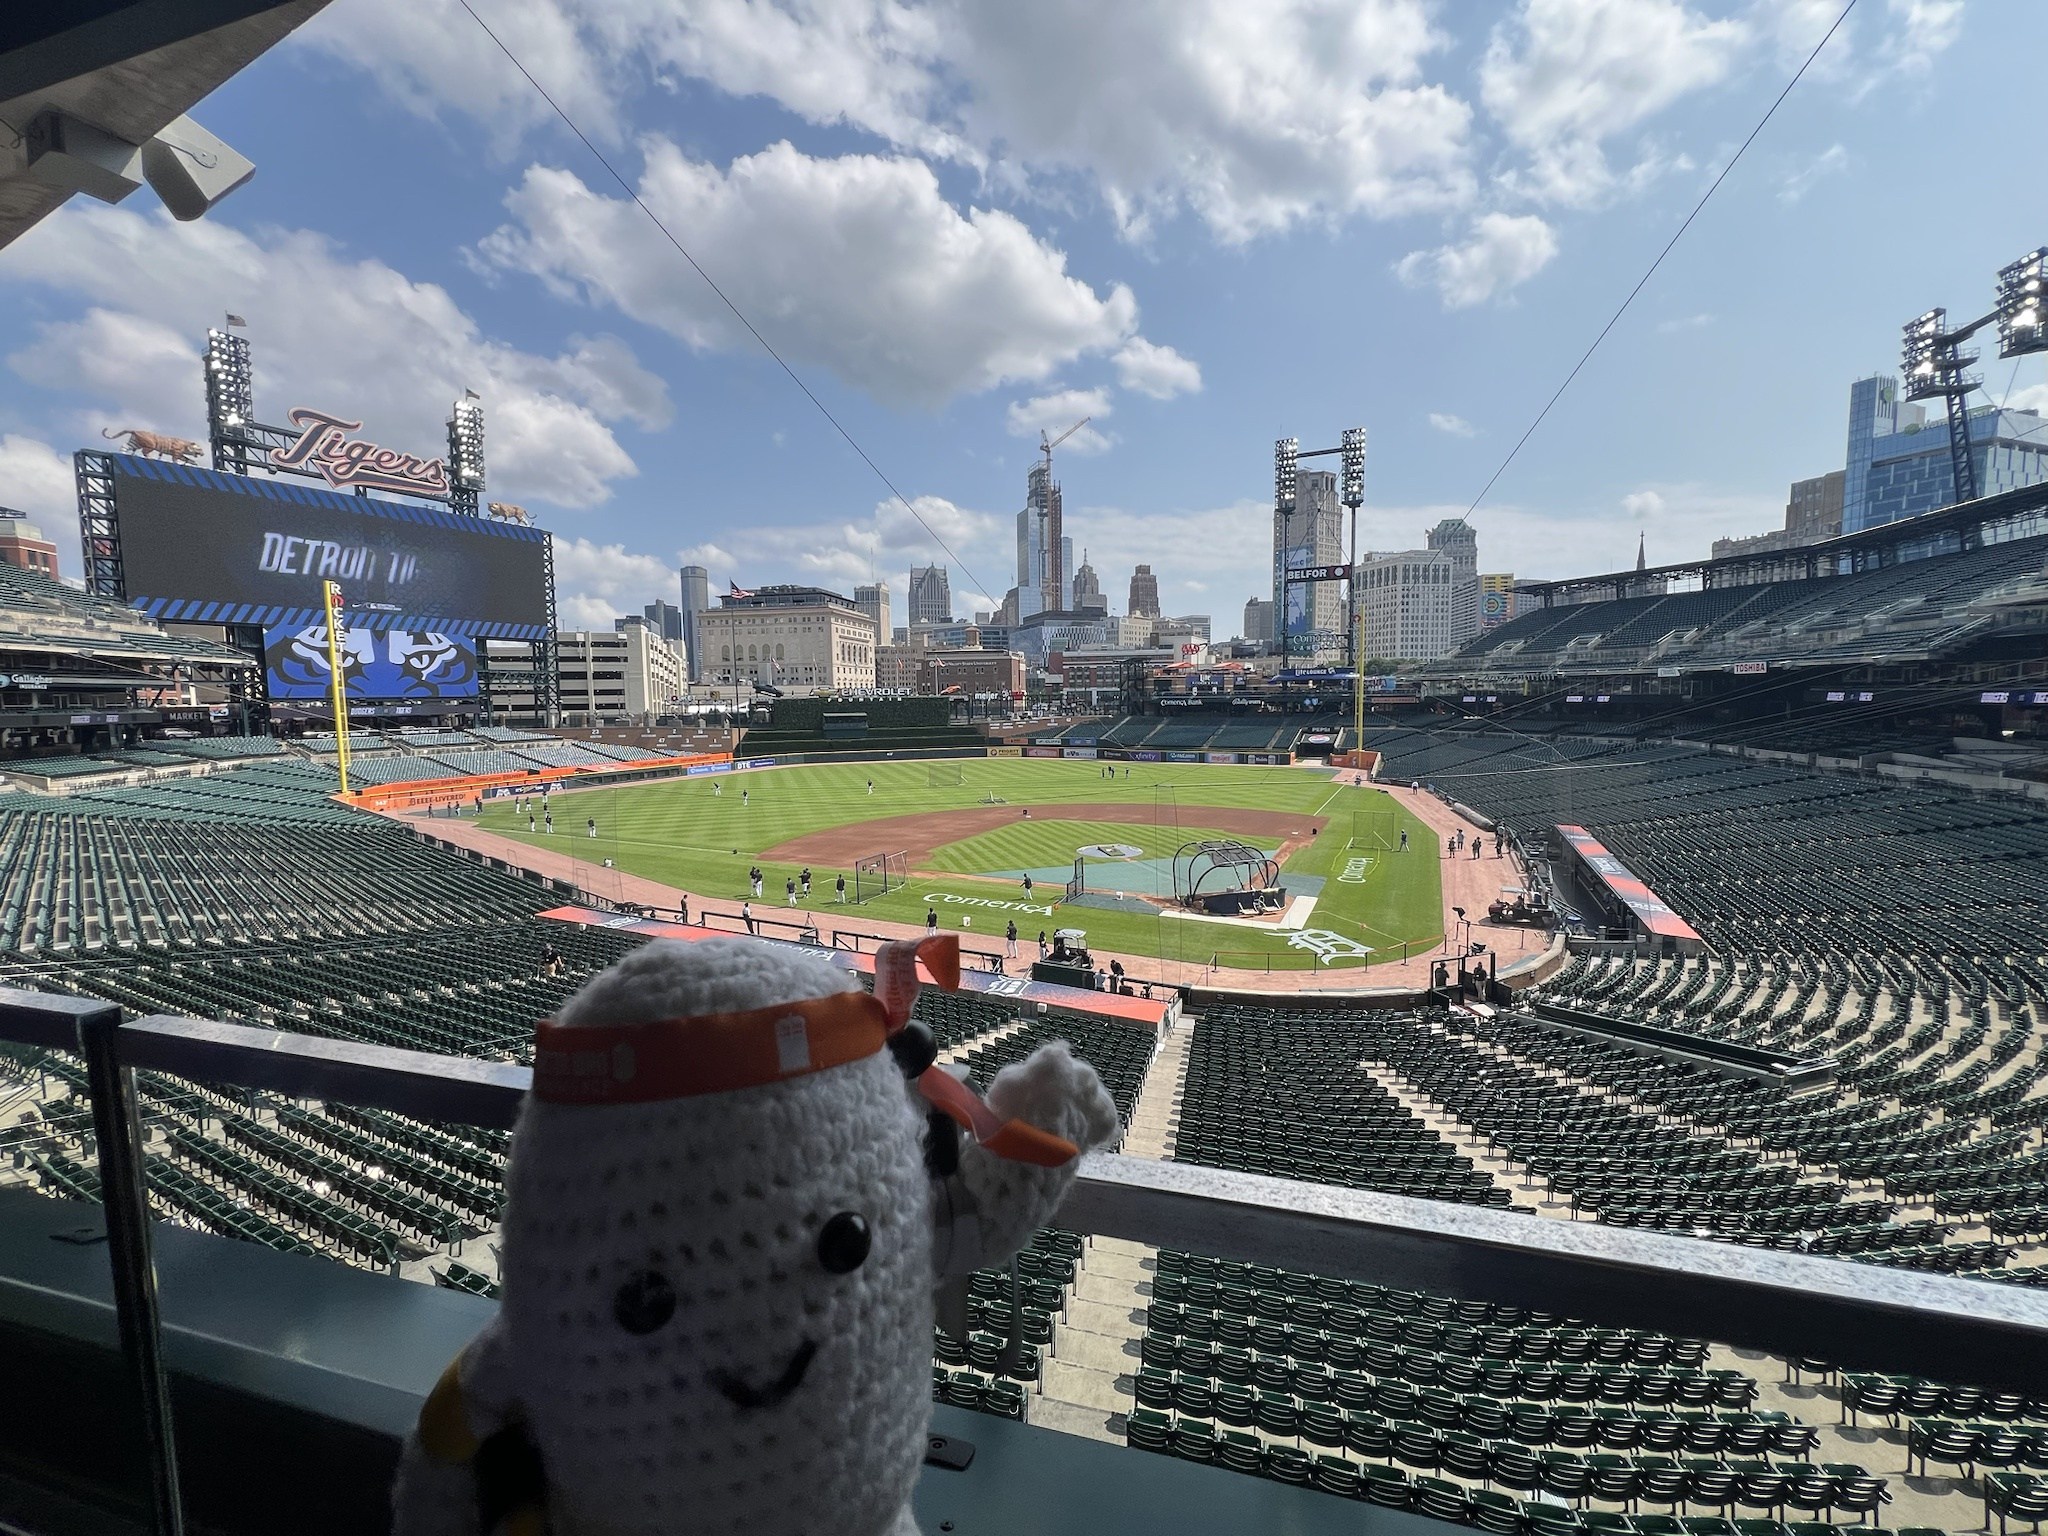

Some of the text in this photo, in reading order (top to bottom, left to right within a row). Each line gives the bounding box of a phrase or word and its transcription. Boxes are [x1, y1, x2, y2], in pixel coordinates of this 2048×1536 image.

[270, 406, 450, 494] Tigers
[1287, 568, 1327, 580] BELFOR
[1735, 662, 1765, 673] TOSHIBA
[841, 687, 912, 697] CHEVROLET
[974, 691, 999, 701] meijer
[169, 712, 203, 721] MARKET
[1135, 753, 1156, 761] xfinity
[737, 761, 750, 770] DTE
